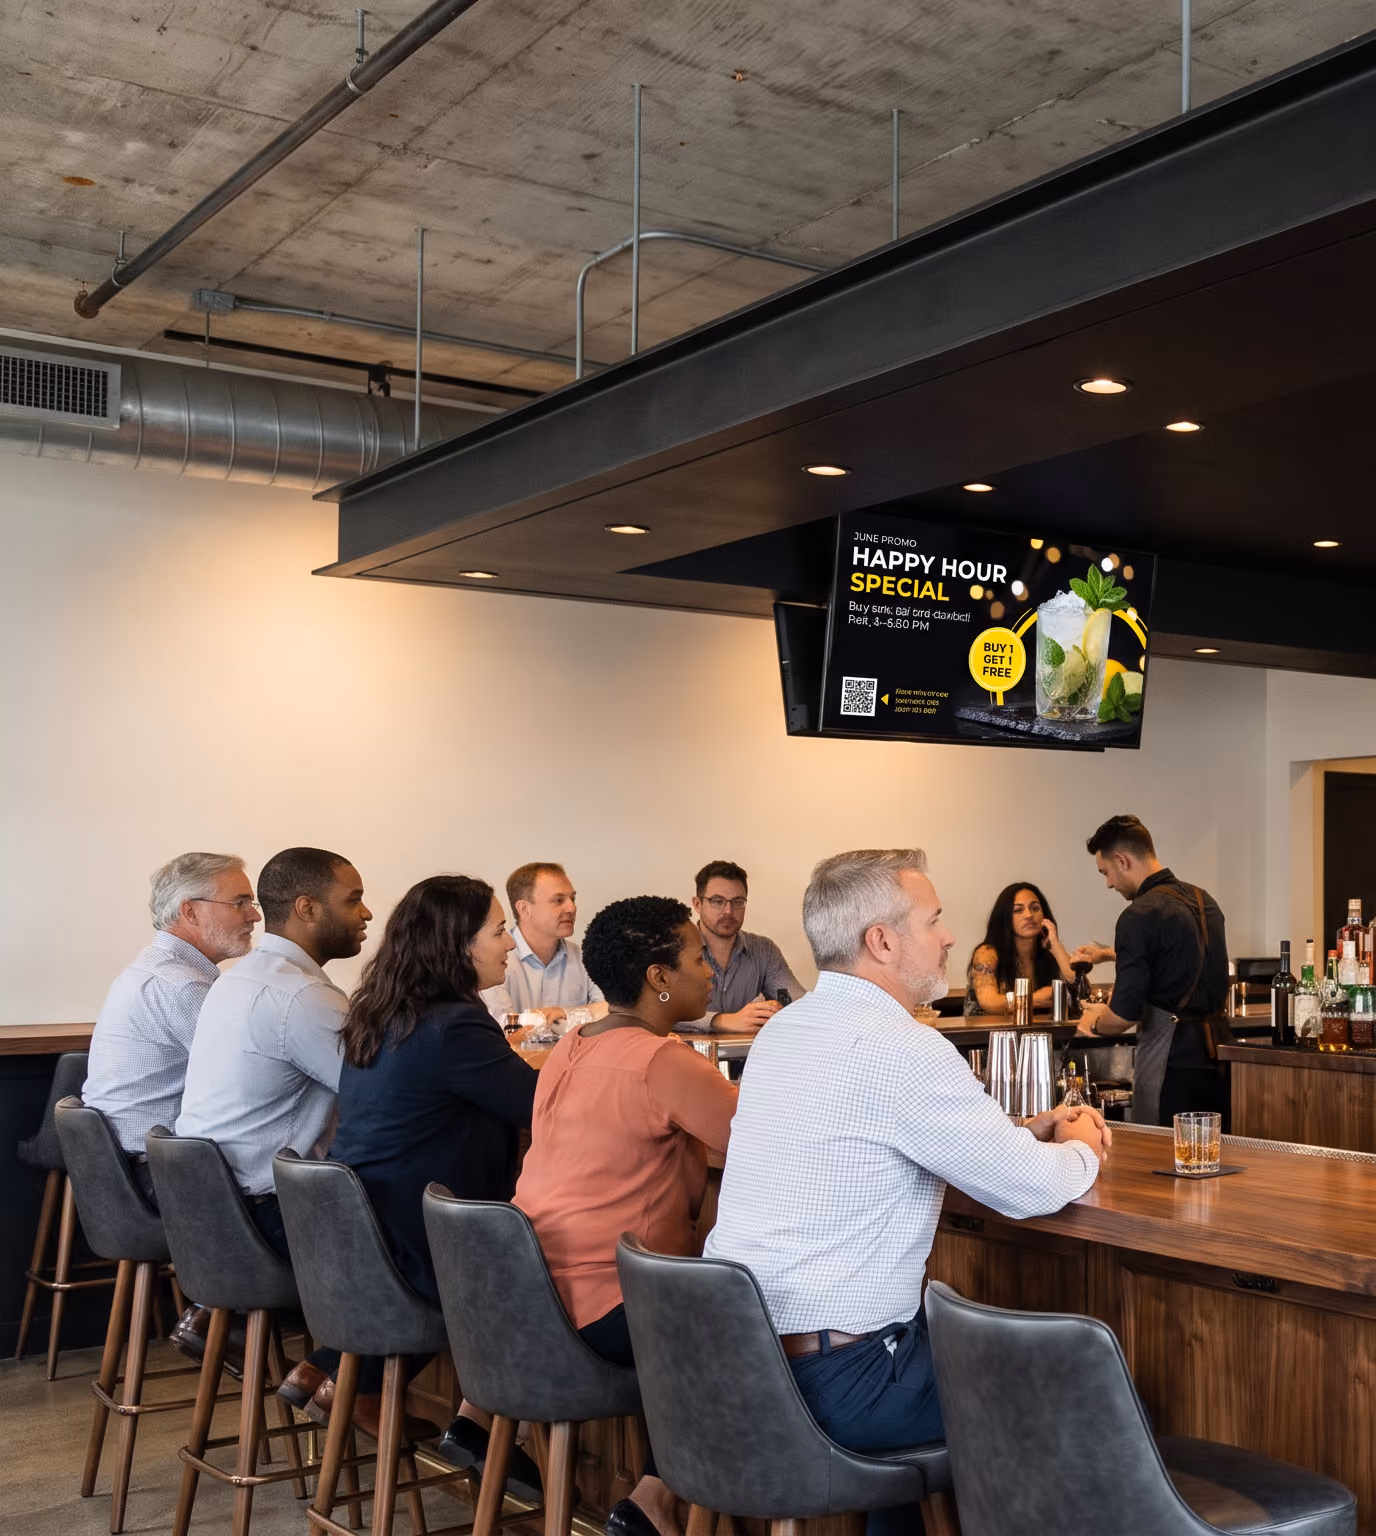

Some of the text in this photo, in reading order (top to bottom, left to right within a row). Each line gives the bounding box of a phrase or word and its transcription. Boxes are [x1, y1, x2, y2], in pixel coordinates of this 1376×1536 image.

[853, 531, 917, 548] JUNE PROMO
[852, 546, 1007, 584] HAPPY HOUR
[850, 572, 950, 601] SPECIAL
[911, 620, 930, 631] PM
[983, 642, 1014, 654] BUY 1
[983, 654, 1005, 665] GET
[982, 666, 1012, 678] FREE
